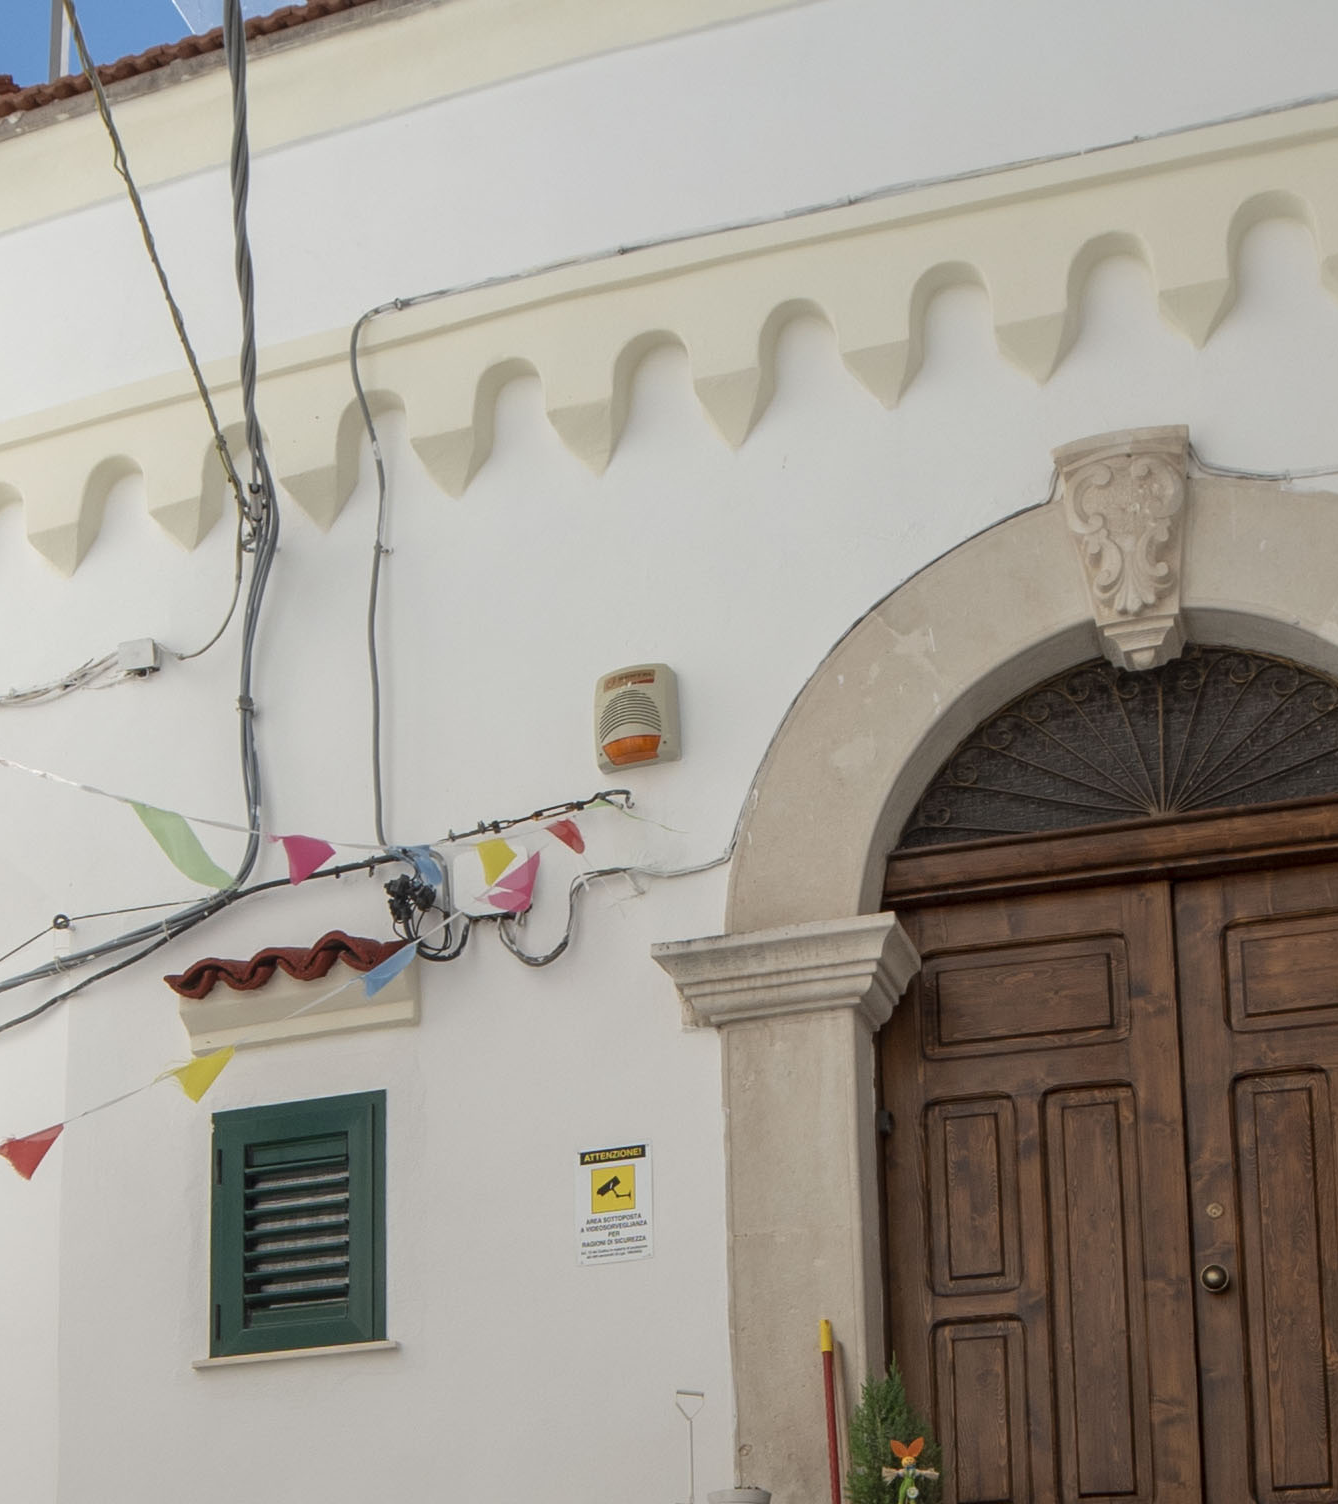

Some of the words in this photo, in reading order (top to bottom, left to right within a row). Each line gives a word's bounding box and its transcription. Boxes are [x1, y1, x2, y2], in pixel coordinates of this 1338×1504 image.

[584, 1147, 642, 1163] ATTENZIONE!
[586, 1217, 602, 1225] AREA
[603, 1212, 641, 1224] SOTTOPOSTA
[586, 1219, 648, 1232] VIDEOSORVEGLIANZA
[607, 1230, 620, 1238] PER
[581, 1239, 606, 1248] RAGIONI
[614, 1234, 647, 1244] SICUREZZA
